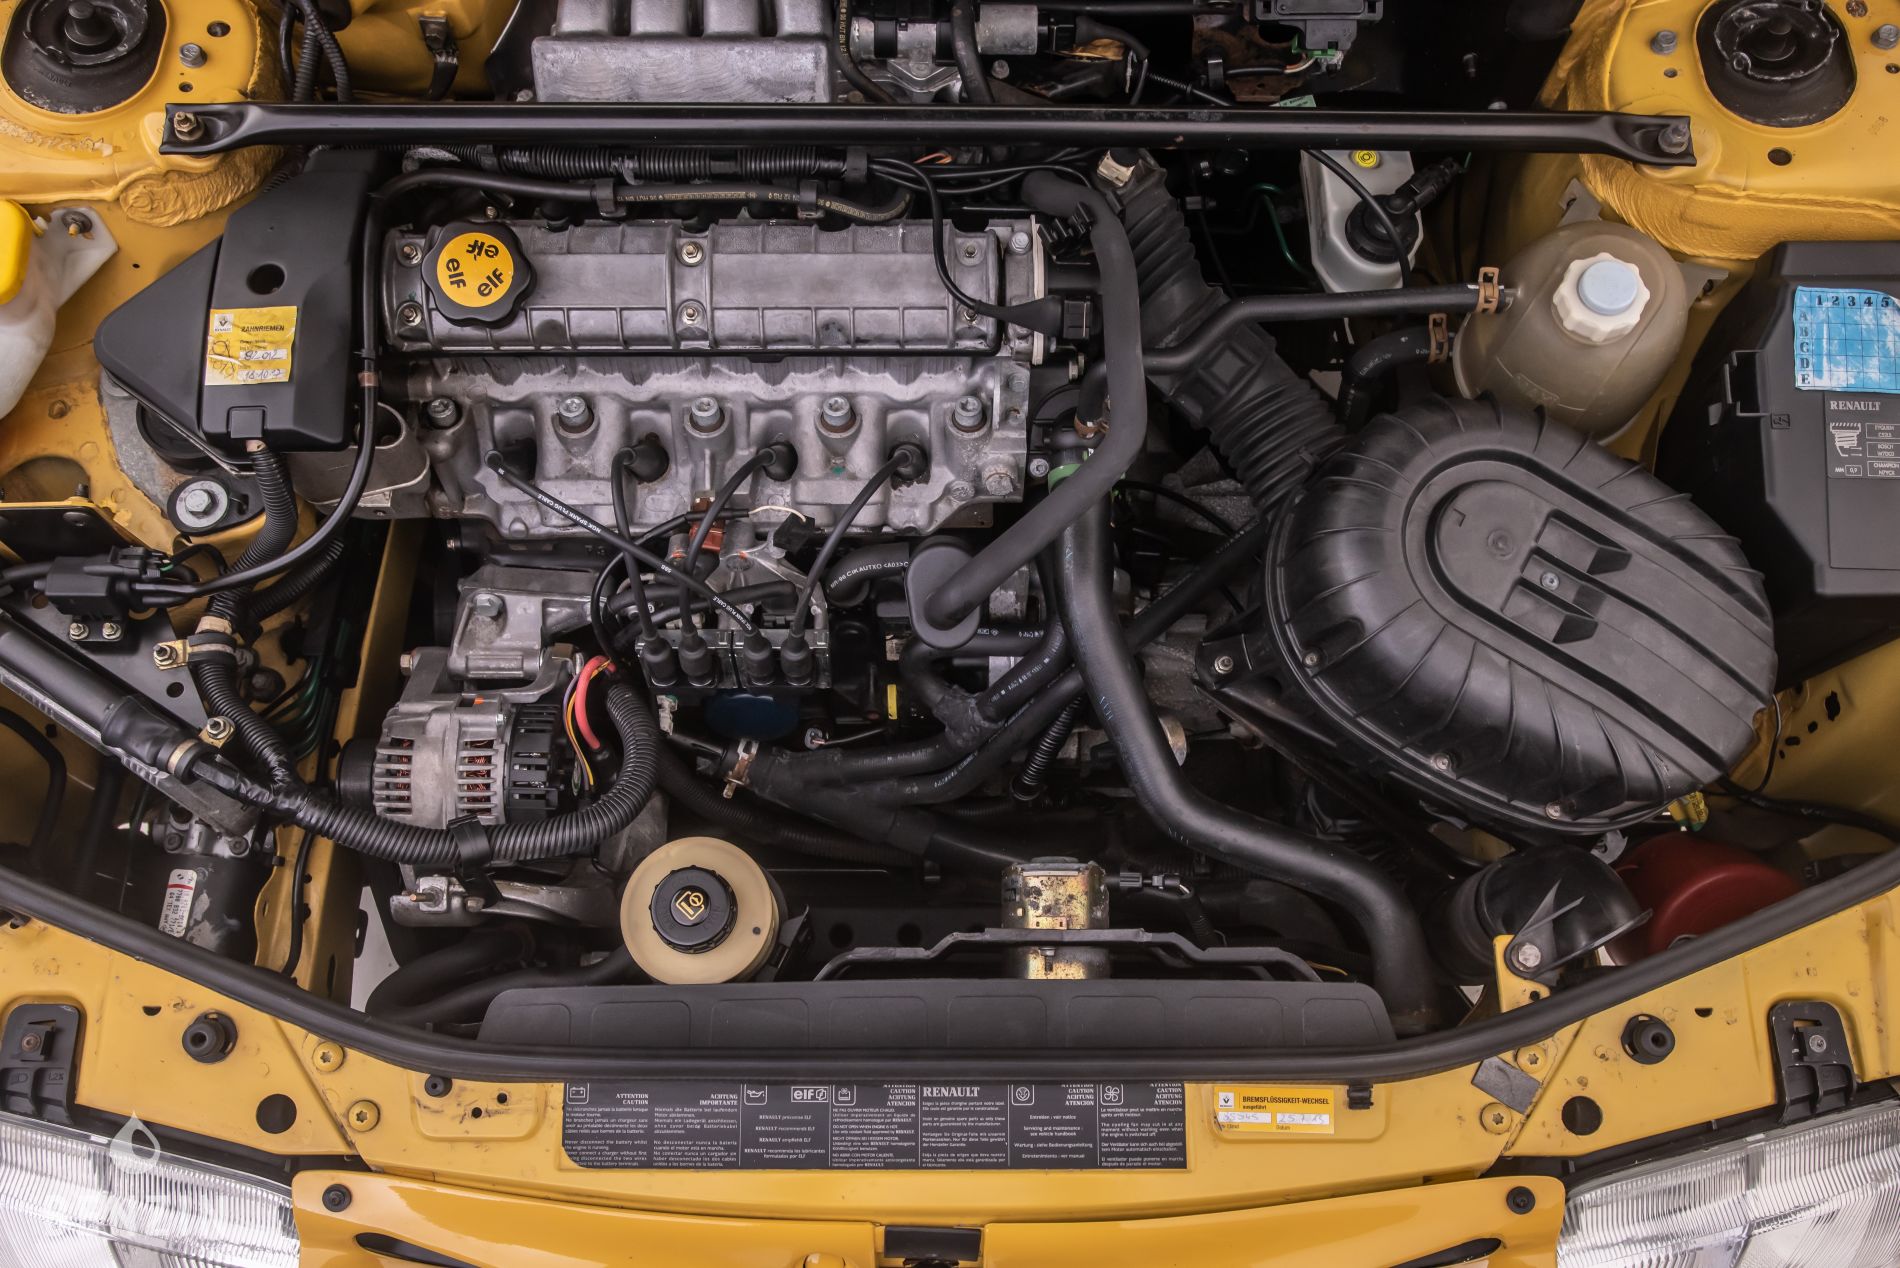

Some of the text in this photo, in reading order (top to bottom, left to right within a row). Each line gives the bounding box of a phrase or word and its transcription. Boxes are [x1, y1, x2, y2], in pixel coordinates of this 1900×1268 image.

[466, 240, 499, 258] elf
[446, 258, 466, 288] elf
[478, 268, 504, 296] elf
[1816, 295, 1890, 308] 1 2 3 4 5
[1800, 358, 1810, 368] D
[1801, 374, 1810, 384] E
[1830, 401, 1880, 410] RENAULT
[554, 503, 568, 516] PLUG
[568, 511, 588, 526] SPARK
[794, 1089, 814, 1099] elf
[923, 1087, 980, 1097] RENAULT
[1243, 1096, 1330, 1105] BREMSFLÜSSIGKEIT-WECHSEL
